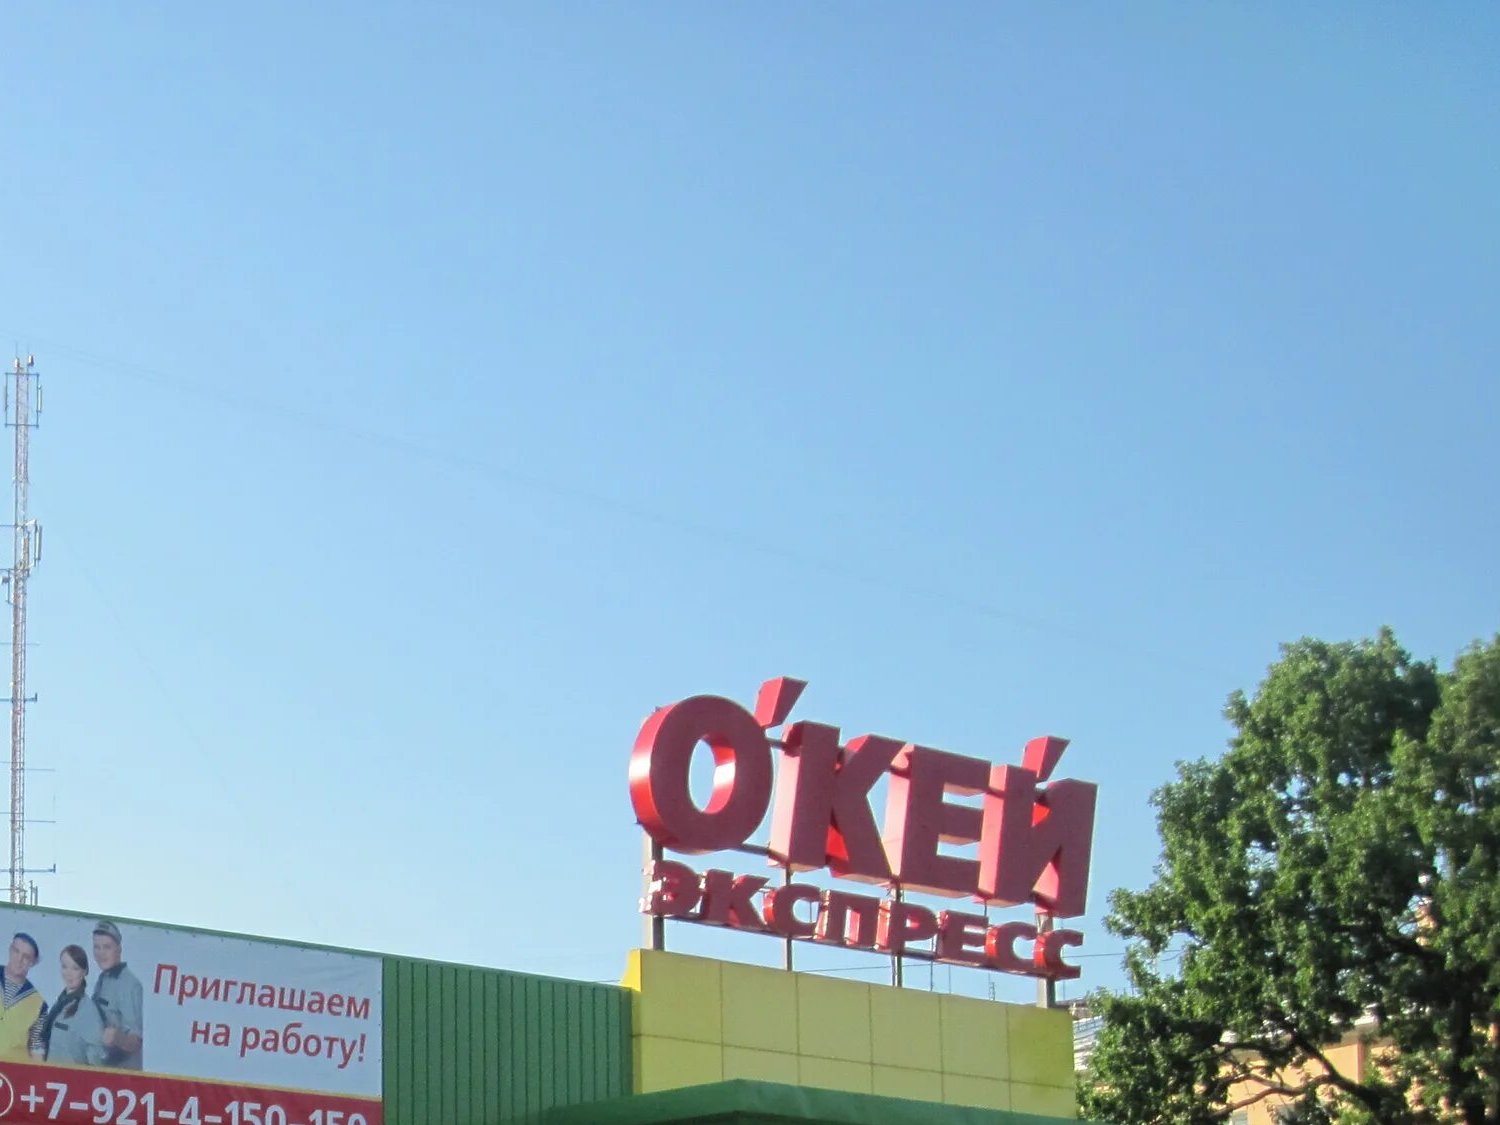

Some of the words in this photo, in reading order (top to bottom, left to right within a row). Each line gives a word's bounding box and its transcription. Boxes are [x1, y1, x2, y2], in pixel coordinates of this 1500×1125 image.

[638, 860, 1085, 981] ЭКСПРЕСС
[153, 963, 372, 1020] Приглашаем
[190, 1018, 229, 1048] на
[239, 1021, 367, 1070] работу!
